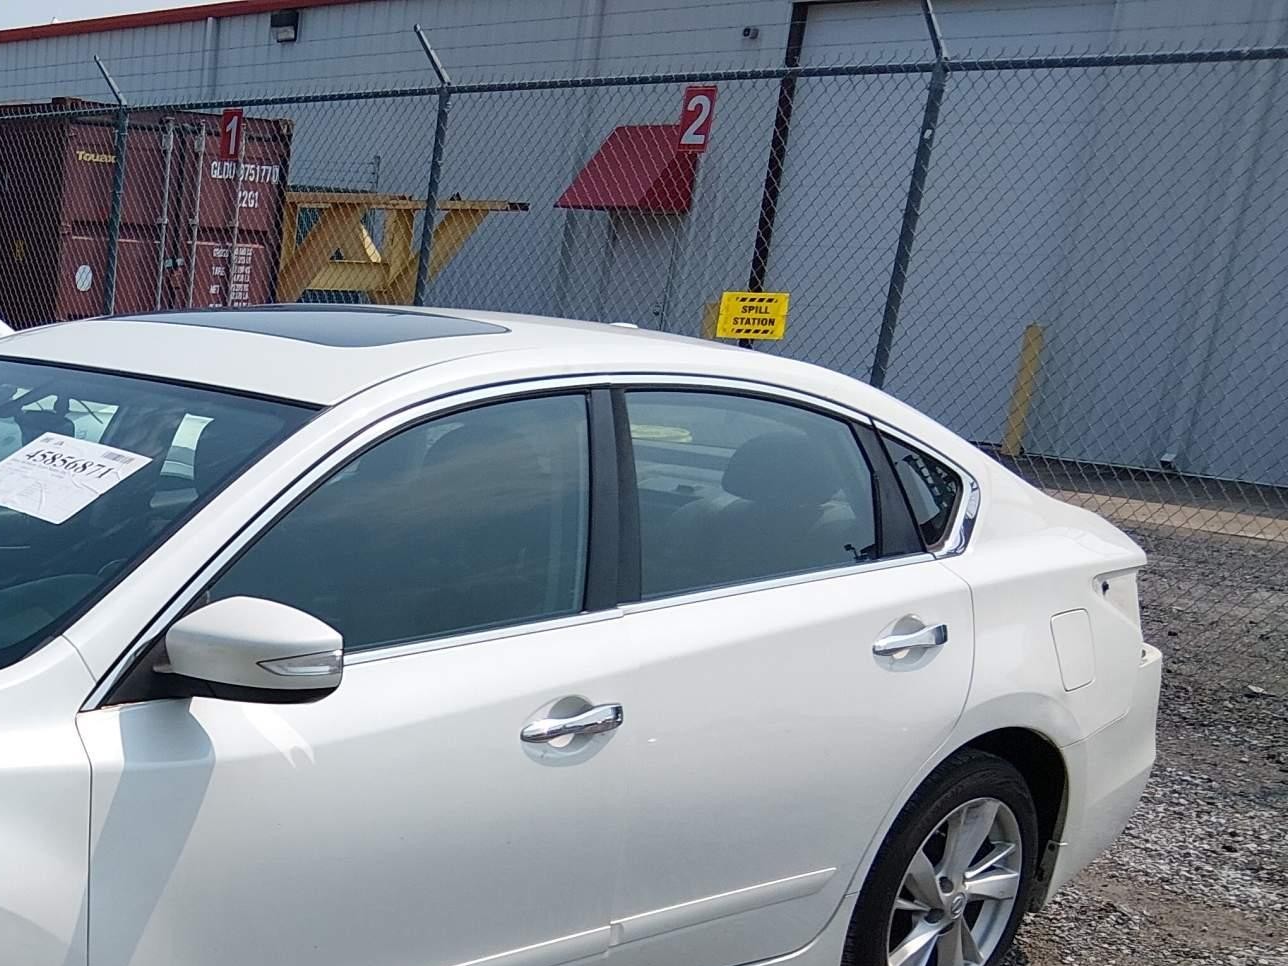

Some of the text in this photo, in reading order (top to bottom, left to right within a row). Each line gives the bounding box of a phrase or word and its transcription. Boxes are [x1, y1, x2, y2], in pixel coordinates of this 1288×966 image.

[680, 94, 711, 145] 2
[225, 115, 239, 155] 1
[732, 317, 776, 326] STATION
[741, 305, 770, 314] SPILL
[26, 450, 114, 479] 45856871
